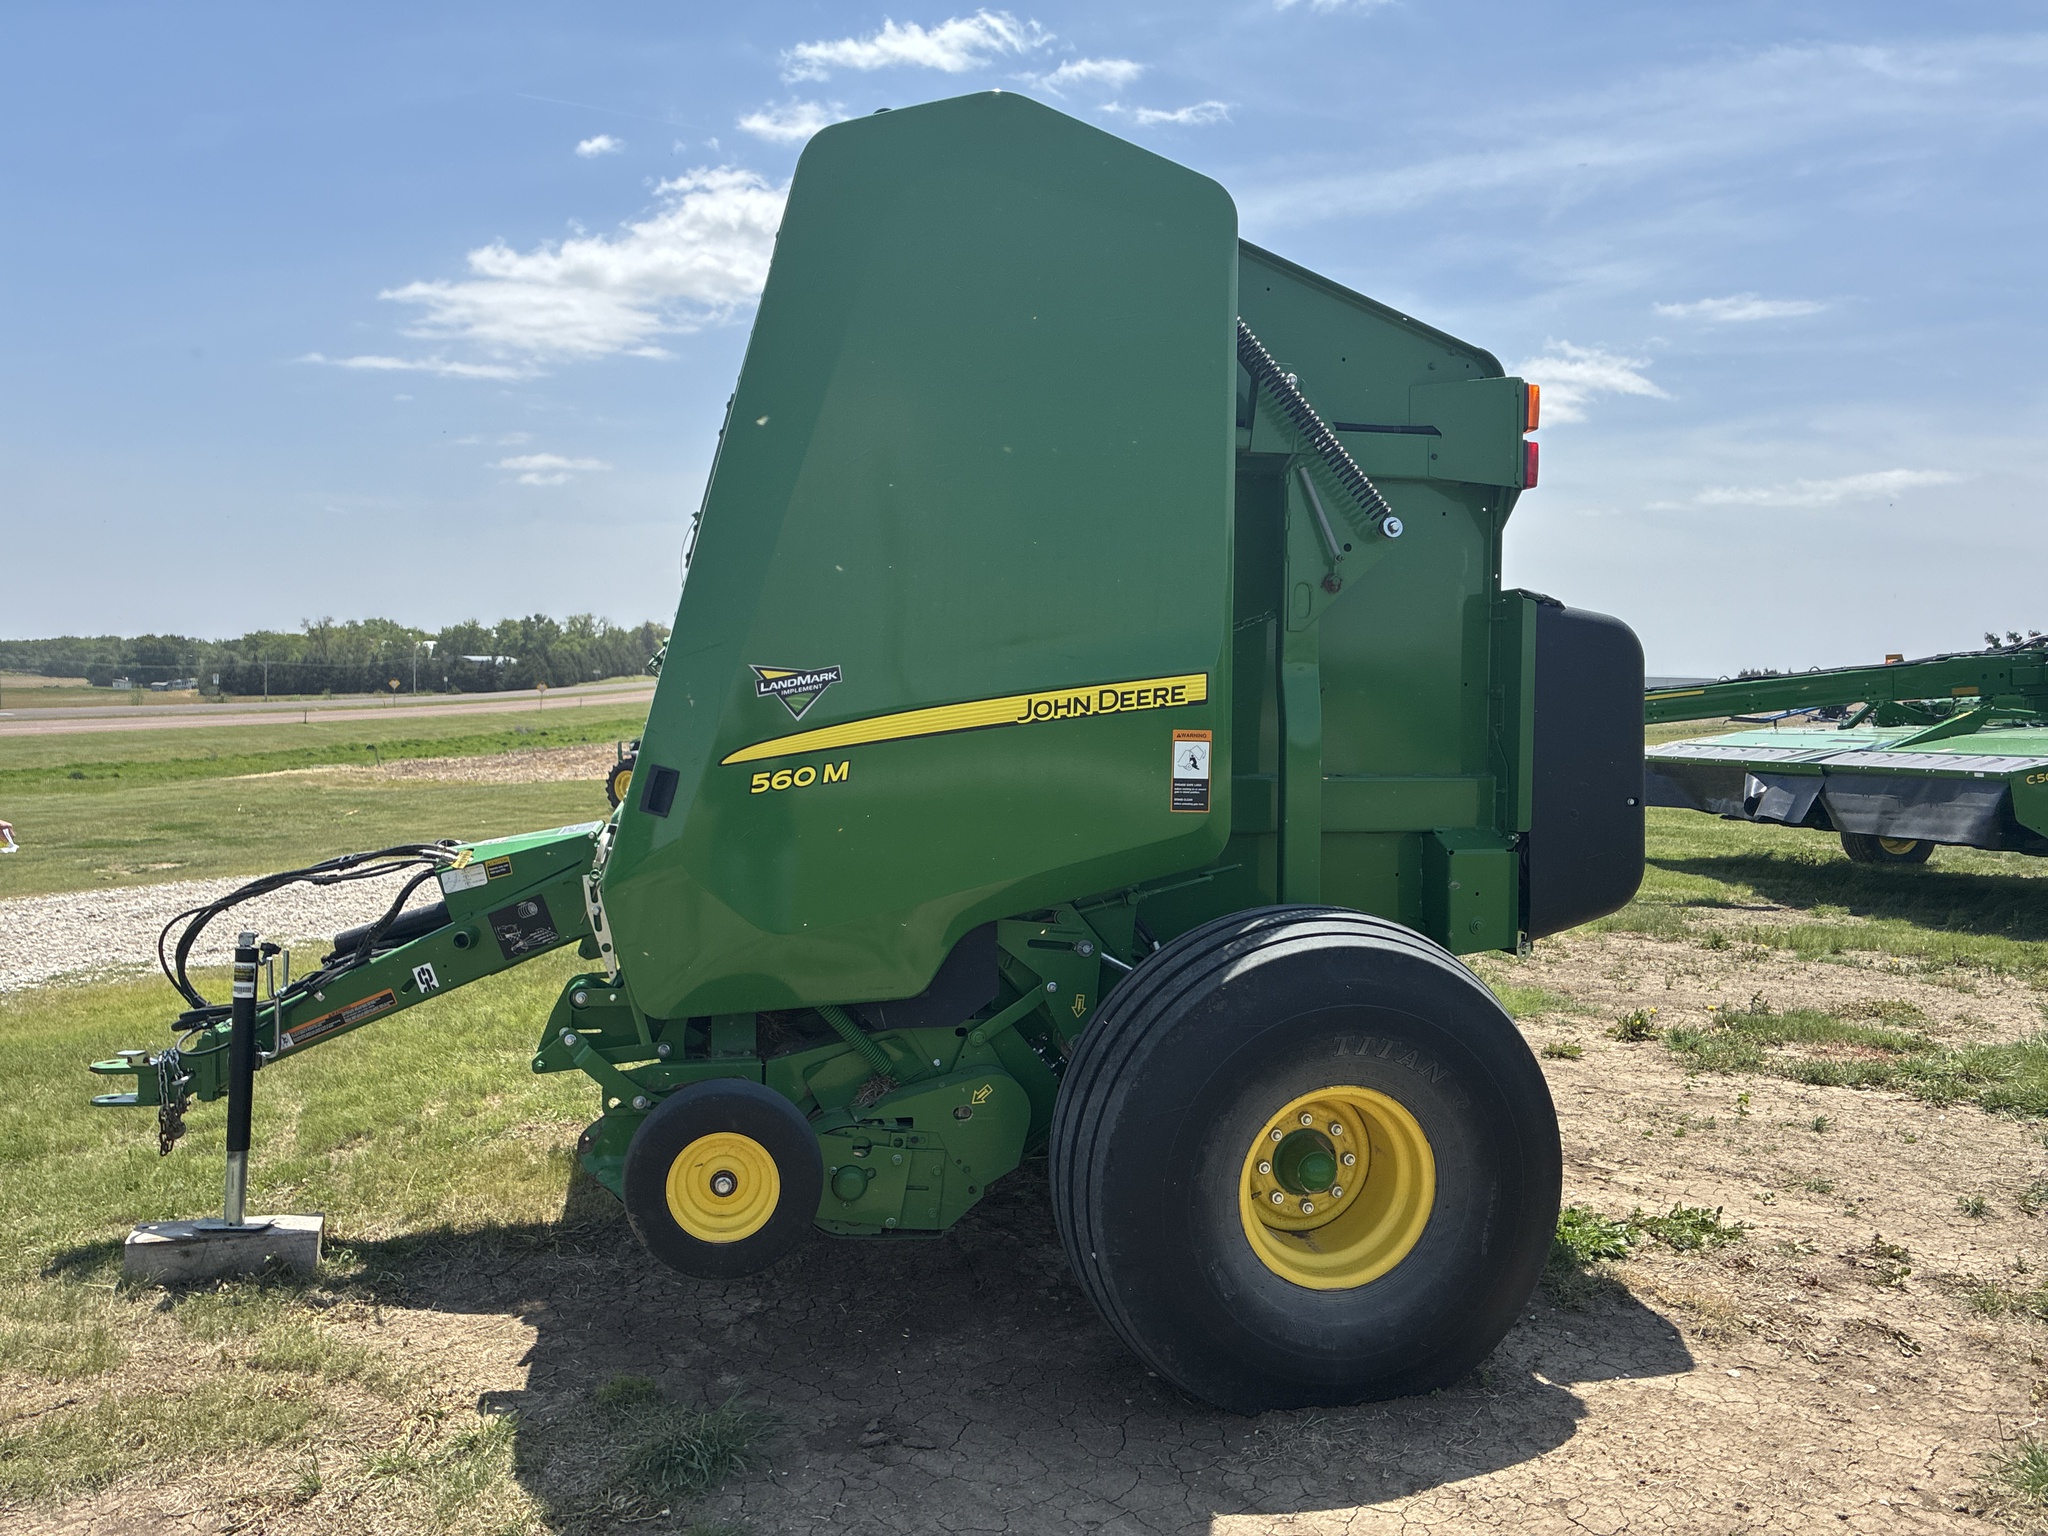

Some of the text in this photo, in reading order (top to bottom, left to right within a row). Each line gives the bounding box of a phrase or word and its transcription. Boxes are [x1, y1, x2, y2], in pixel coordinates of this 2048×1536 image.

[760, 671, 838, 692] LANDMARK
[781, 683, 823, 696] IMPLEMENT
[1017, 685, 1186, 721] JOHN DEERE
[750, 760, 850, 794] 560 M
[1333, 1036, 1449, 1084] TITAN
